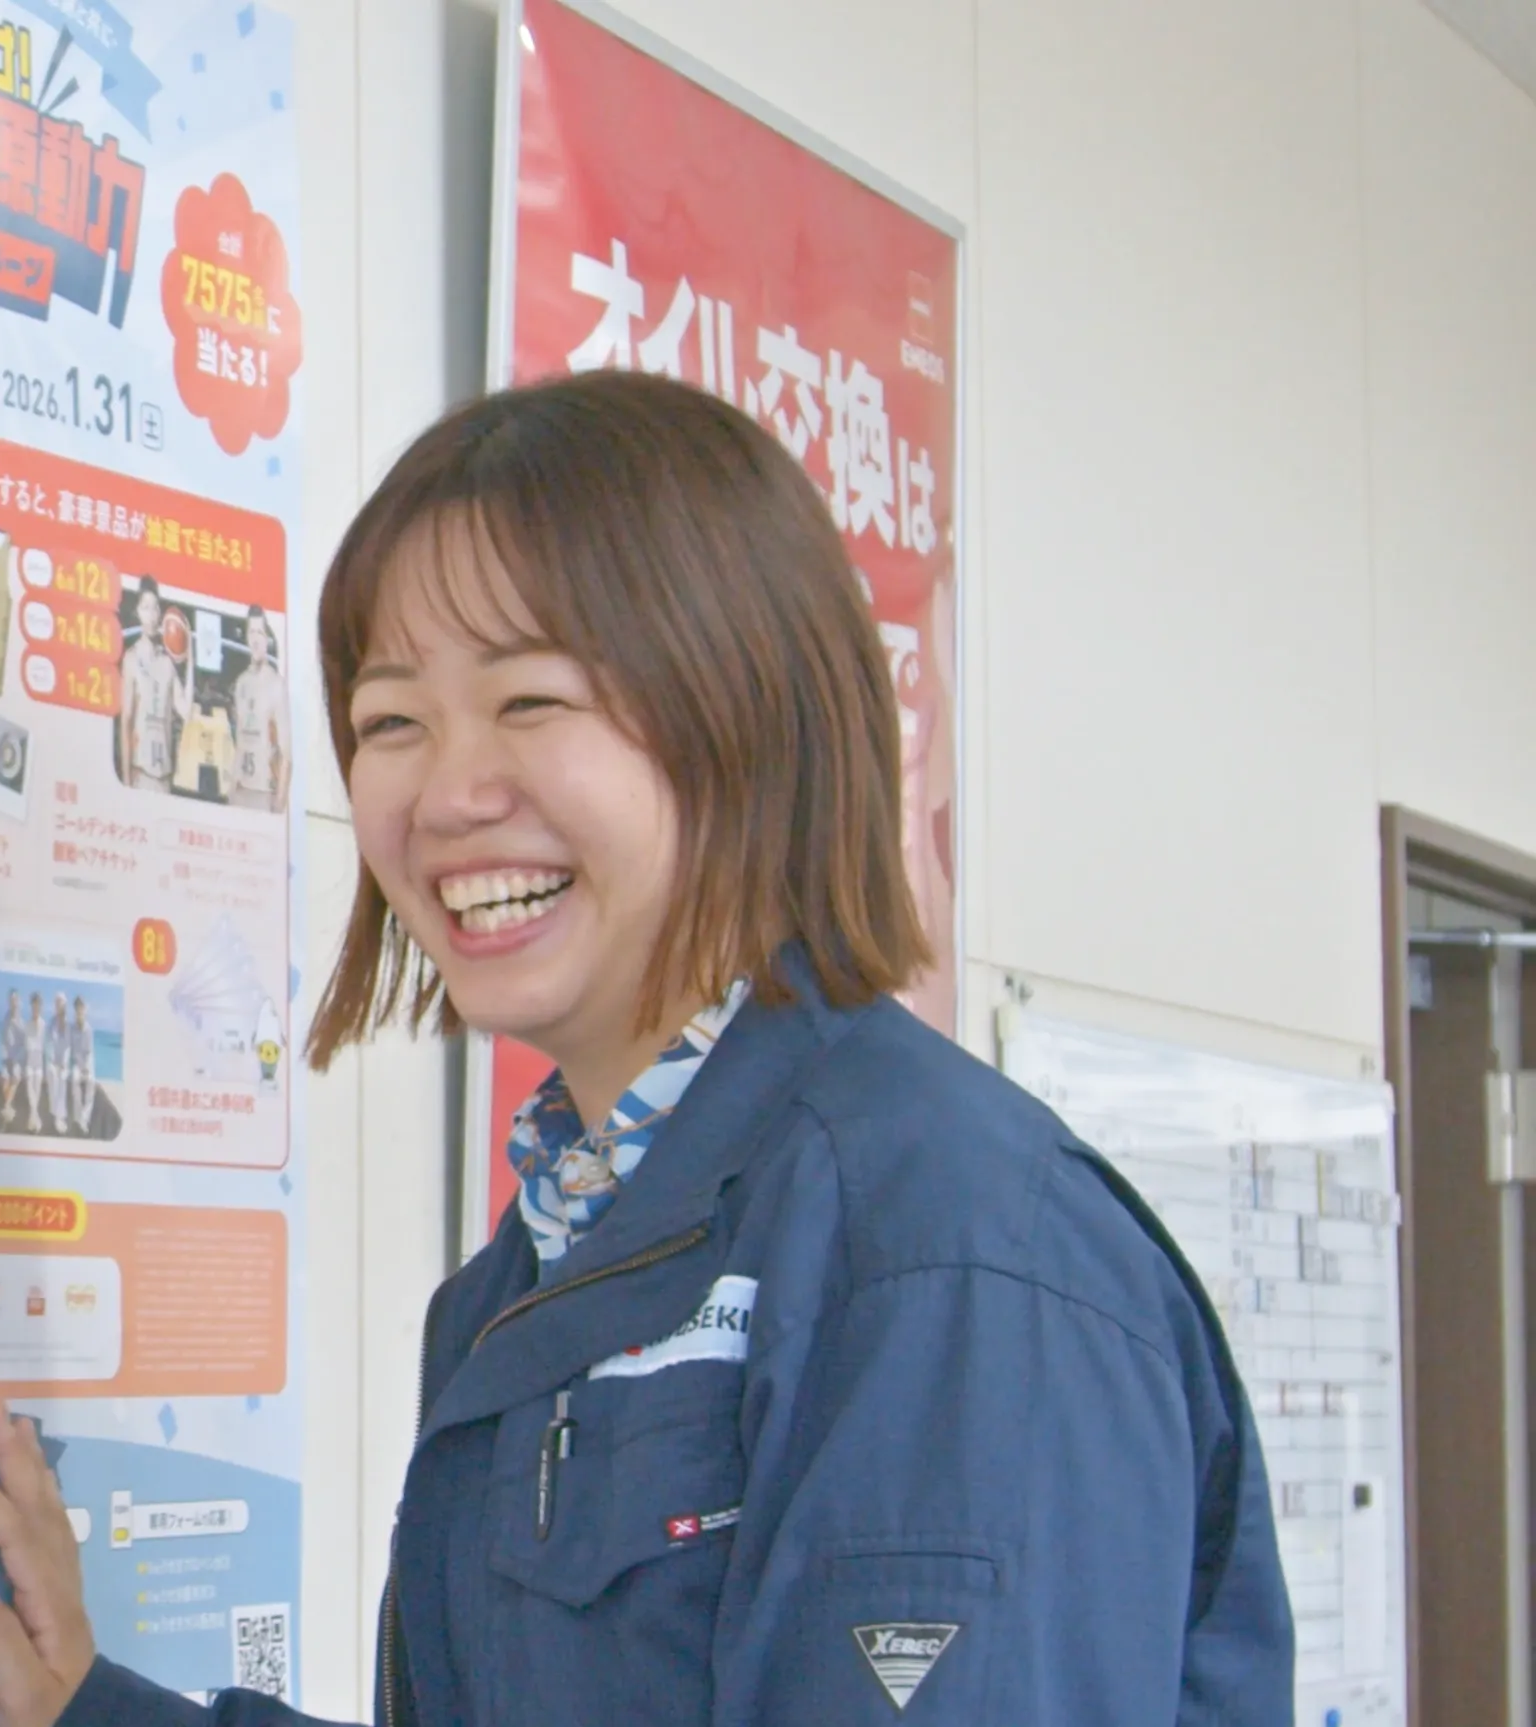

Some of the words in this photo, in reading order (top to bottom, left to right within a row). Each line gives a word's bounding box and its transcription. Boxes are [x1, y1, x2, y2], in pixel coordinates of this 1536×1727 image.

[197, 326, 269, 388] 当たる!
[567, 237, 938, 556] オイル交換は
[870, 1630, 942, 1656] XEBEC
